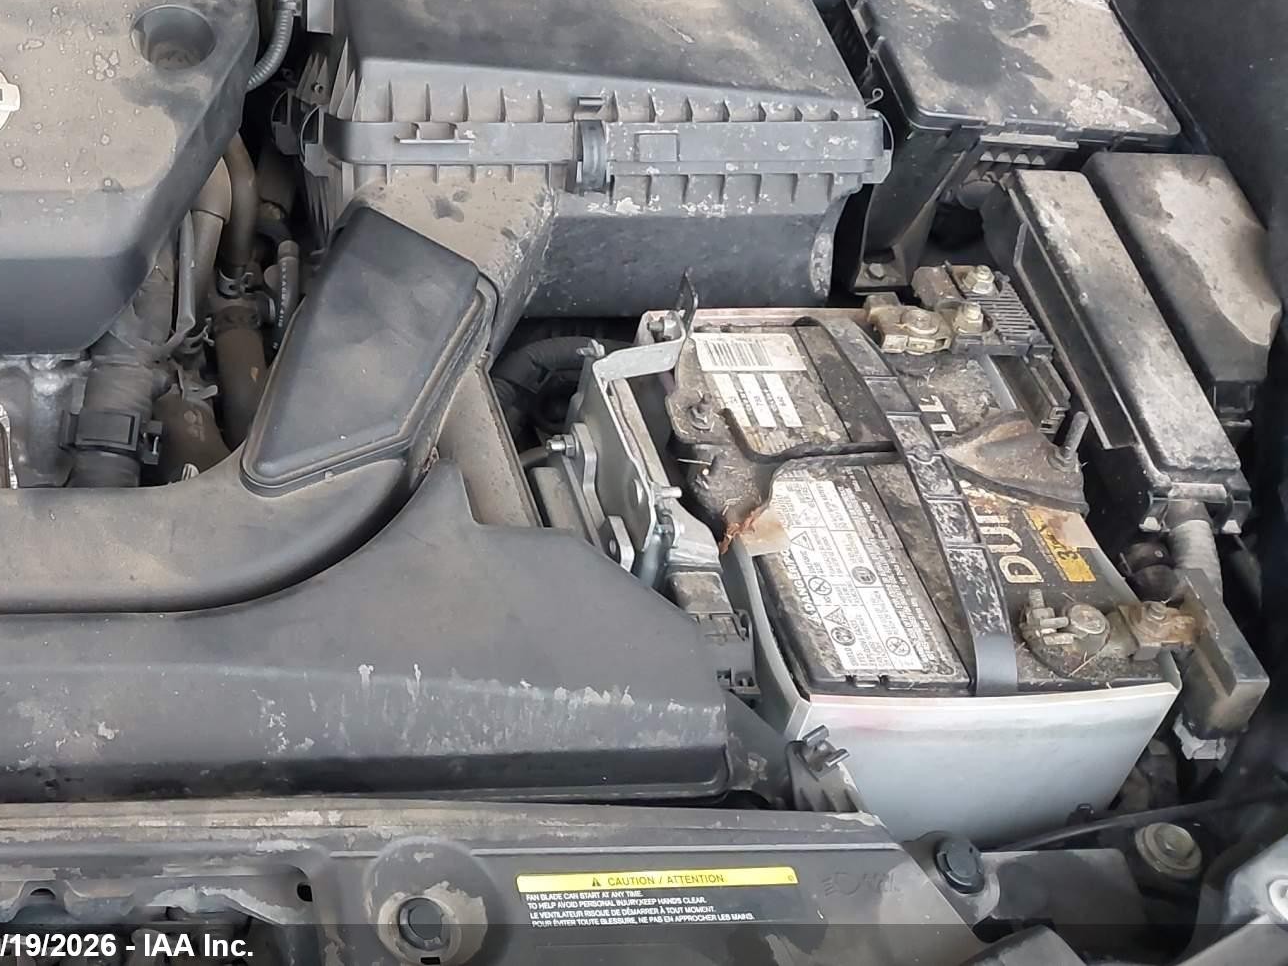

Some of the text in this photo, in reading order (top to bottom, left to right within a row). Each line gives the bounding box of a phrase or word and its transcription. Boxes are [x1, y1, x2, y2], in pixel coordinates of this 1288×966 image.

[607, 875, 655, 886] CAUTION
[667, 873, 724, 884] ATTENTION
[540, 893, 562, 901] BLADE
[602, 891, 610, 899] AT
[528, 902, 538, 910] TO
[557, 901, 578, 909] AVOID
[579, 900, 616, 908] PERSONAL
[539, 911, 583, 919] VENTILATEUR
[532, 920, 552, 928] POUR
[577, 918, 599, 926] TOUTE
[674, 914, 717, 922] APPROCHER
[718, 913, 731, 921] LES
